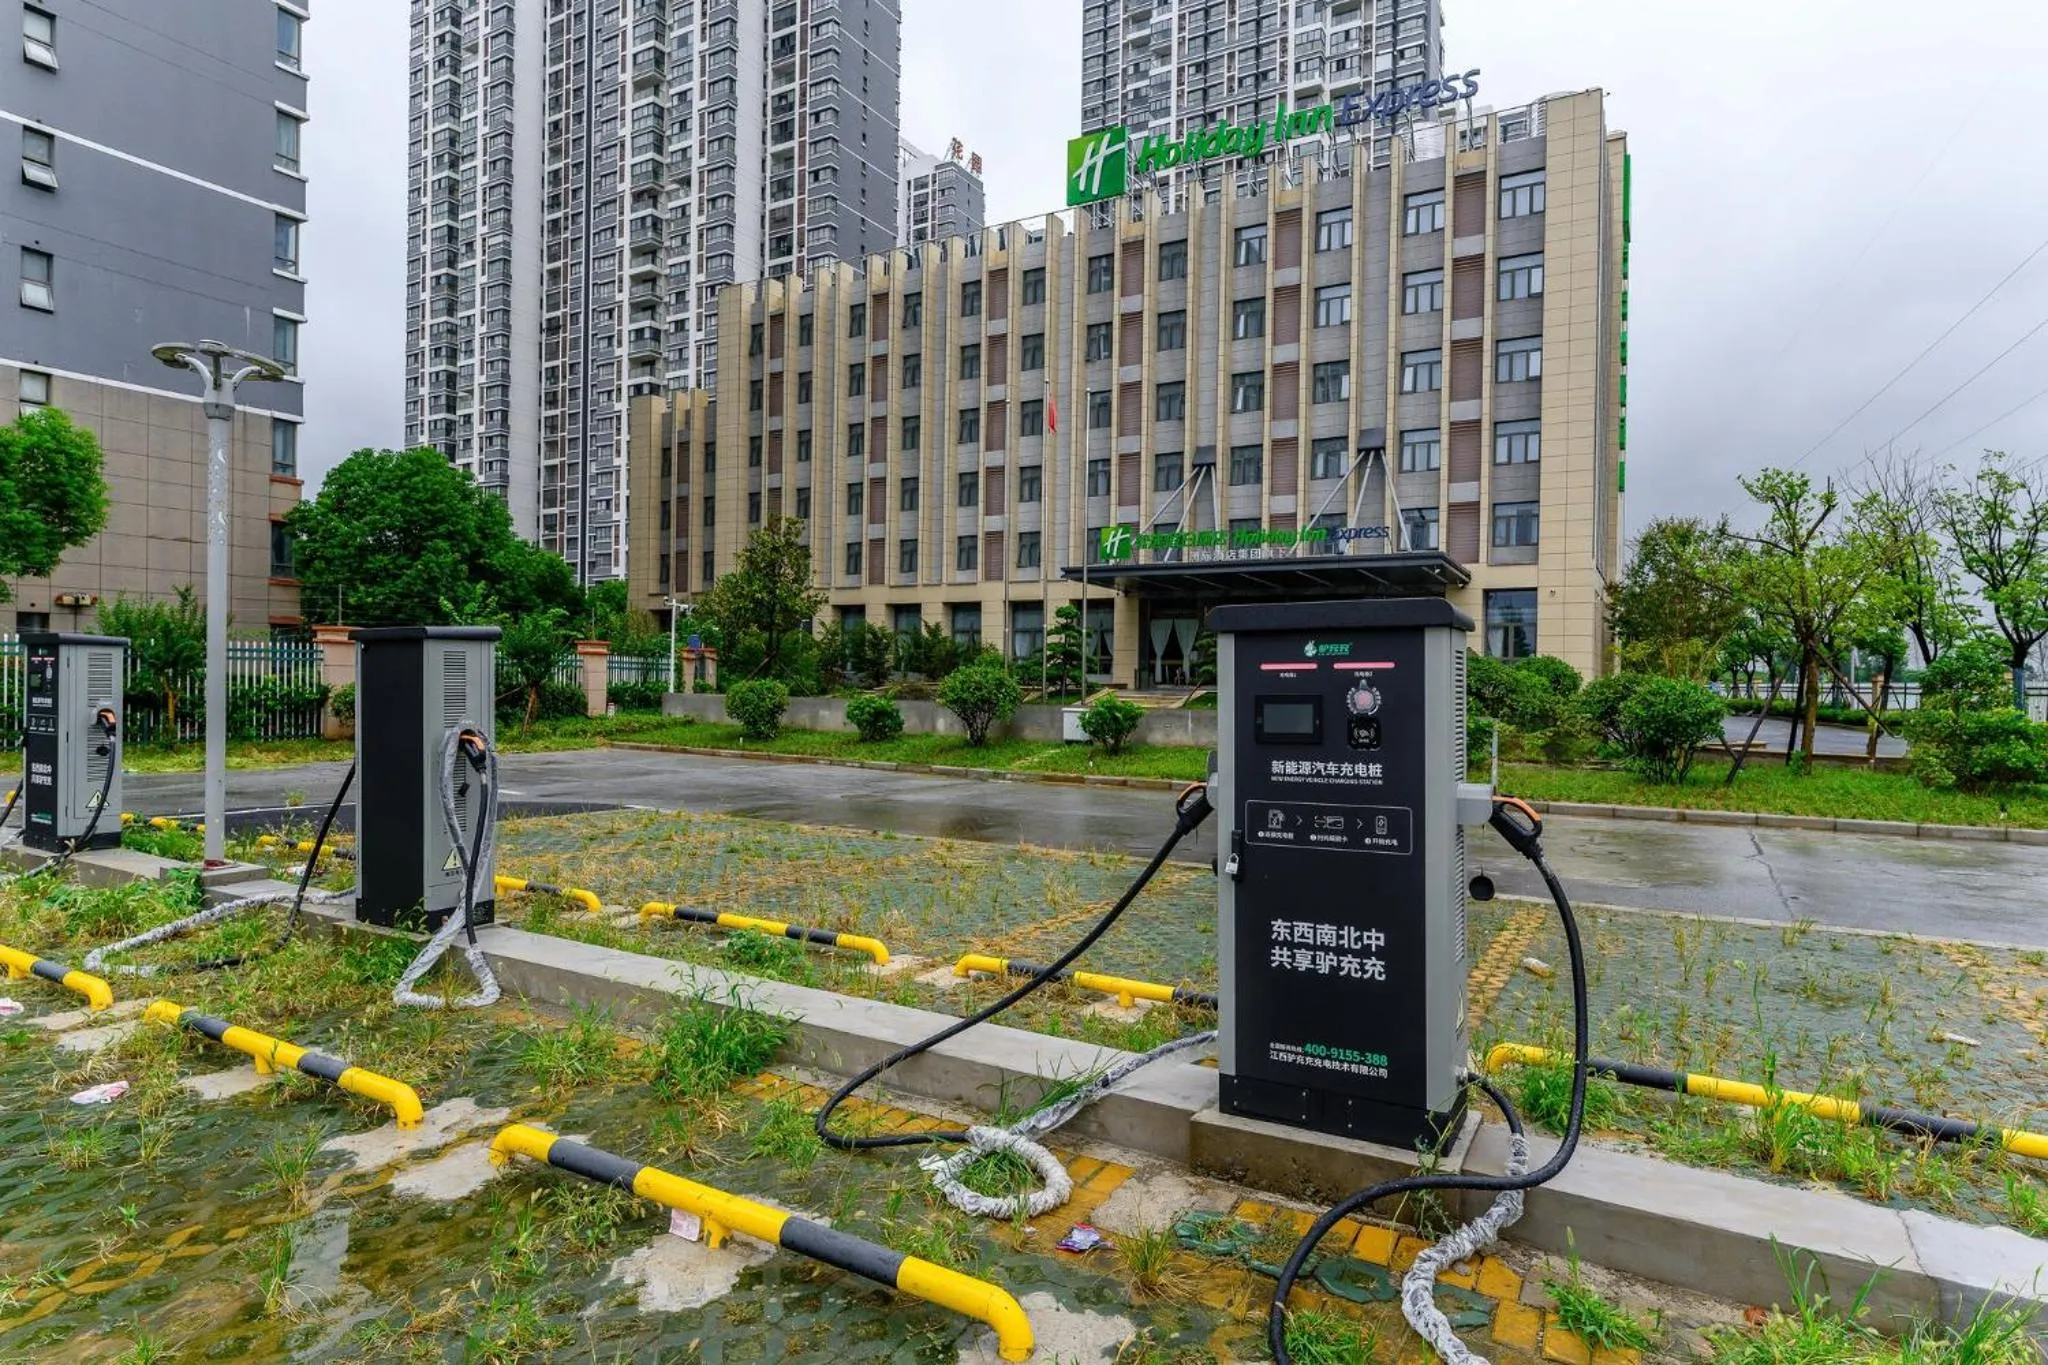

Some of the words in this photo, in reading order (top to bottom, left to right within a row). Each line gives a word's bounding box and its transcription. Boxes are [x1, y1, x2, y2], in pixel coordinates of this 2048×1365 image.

[1136, 120, 1268, 174] Holiday
[1274, 101, 1334, 142] Inn
[1340, 69, 1480, 126] Express
[1329, 525, 1391, 545] Express
[1271, 760, 1383, 778] 新能源汽车充电桩
[1271, 919, 1385, 952] 东西南北中
[1270, 946, 1387, 981] 共享驴充充
[1270, 1050, 1388, 1079] 江西驴充充充电技术有限公司
[1304, 1043, 1388, 1067] 400-9155-388
